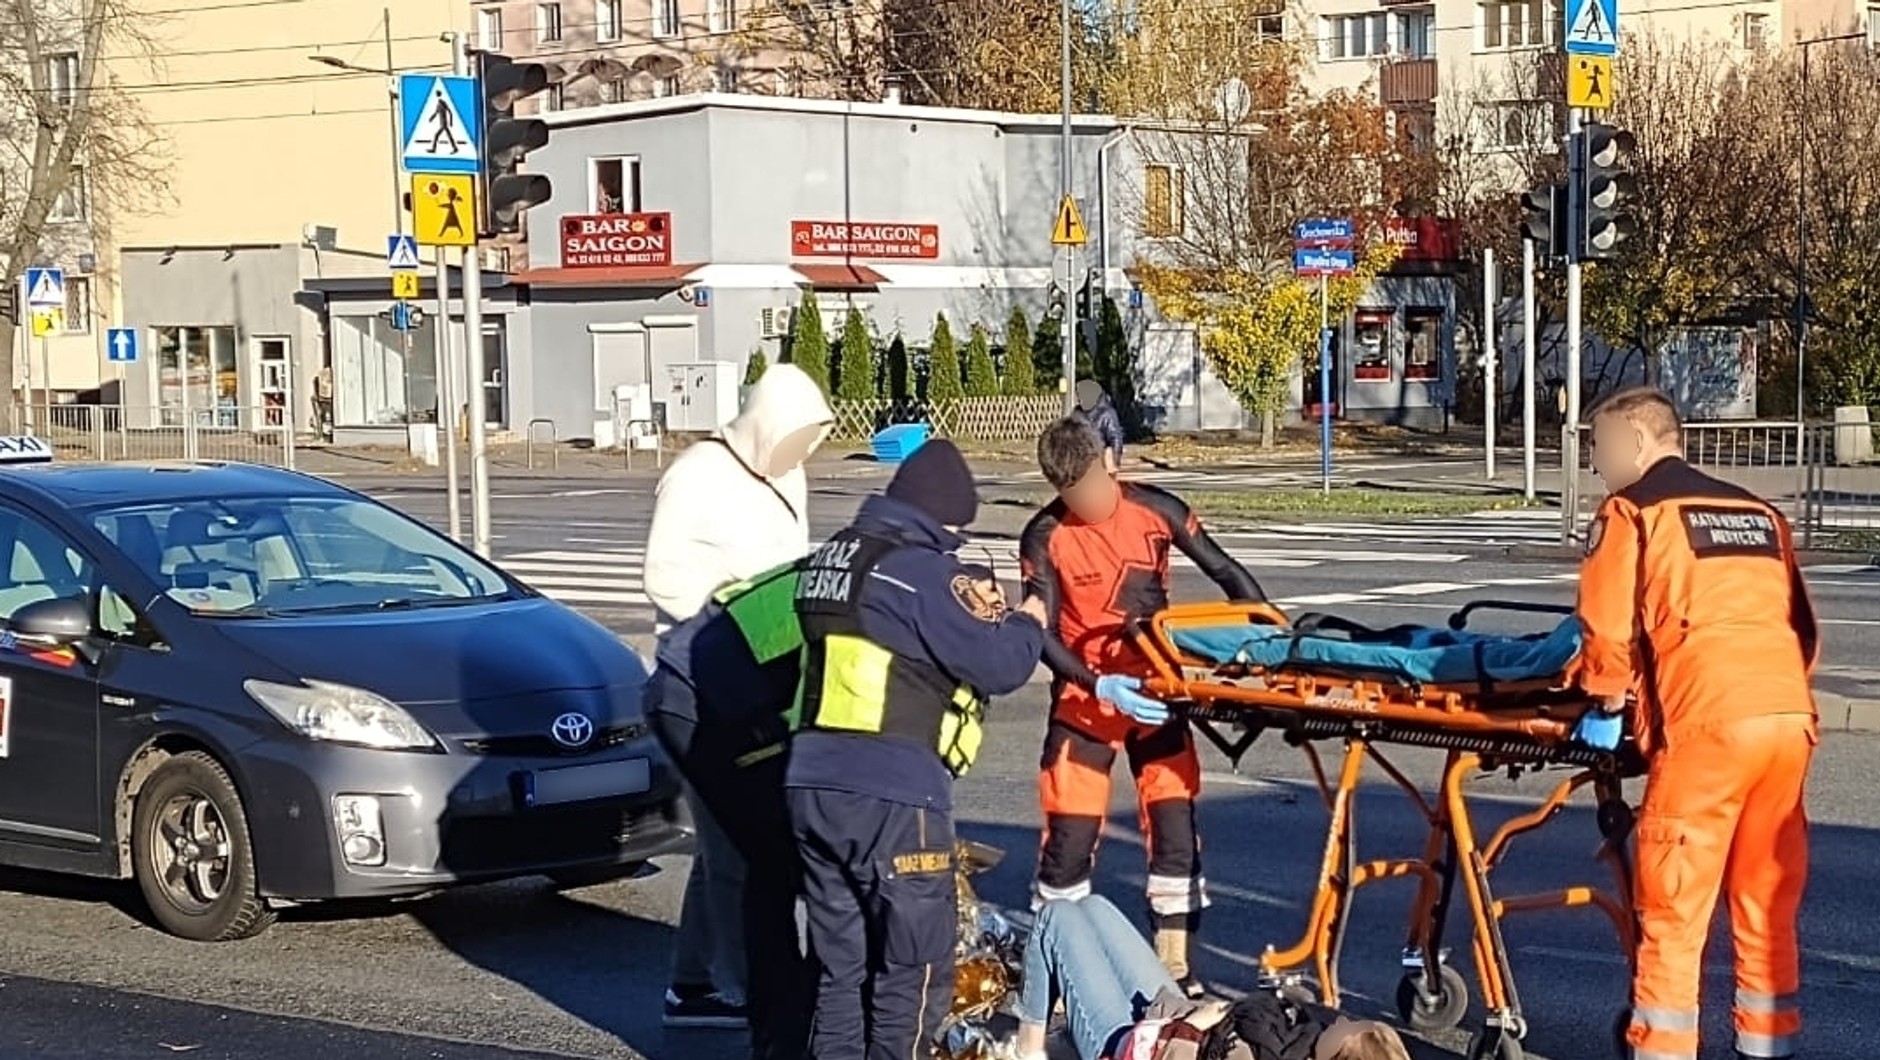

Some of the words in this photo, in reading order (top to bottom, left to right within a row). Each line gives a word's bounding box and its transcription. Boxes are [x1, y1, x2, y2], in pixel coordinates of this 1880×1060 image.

[582, 219, 631, 234] BAR
[812, 224, 848, 240] BAR
[852, 226, 920, 241] SAIGON
[567, 235, 665, 252] SAIGON
[0, 437, 42, 452] AXI
